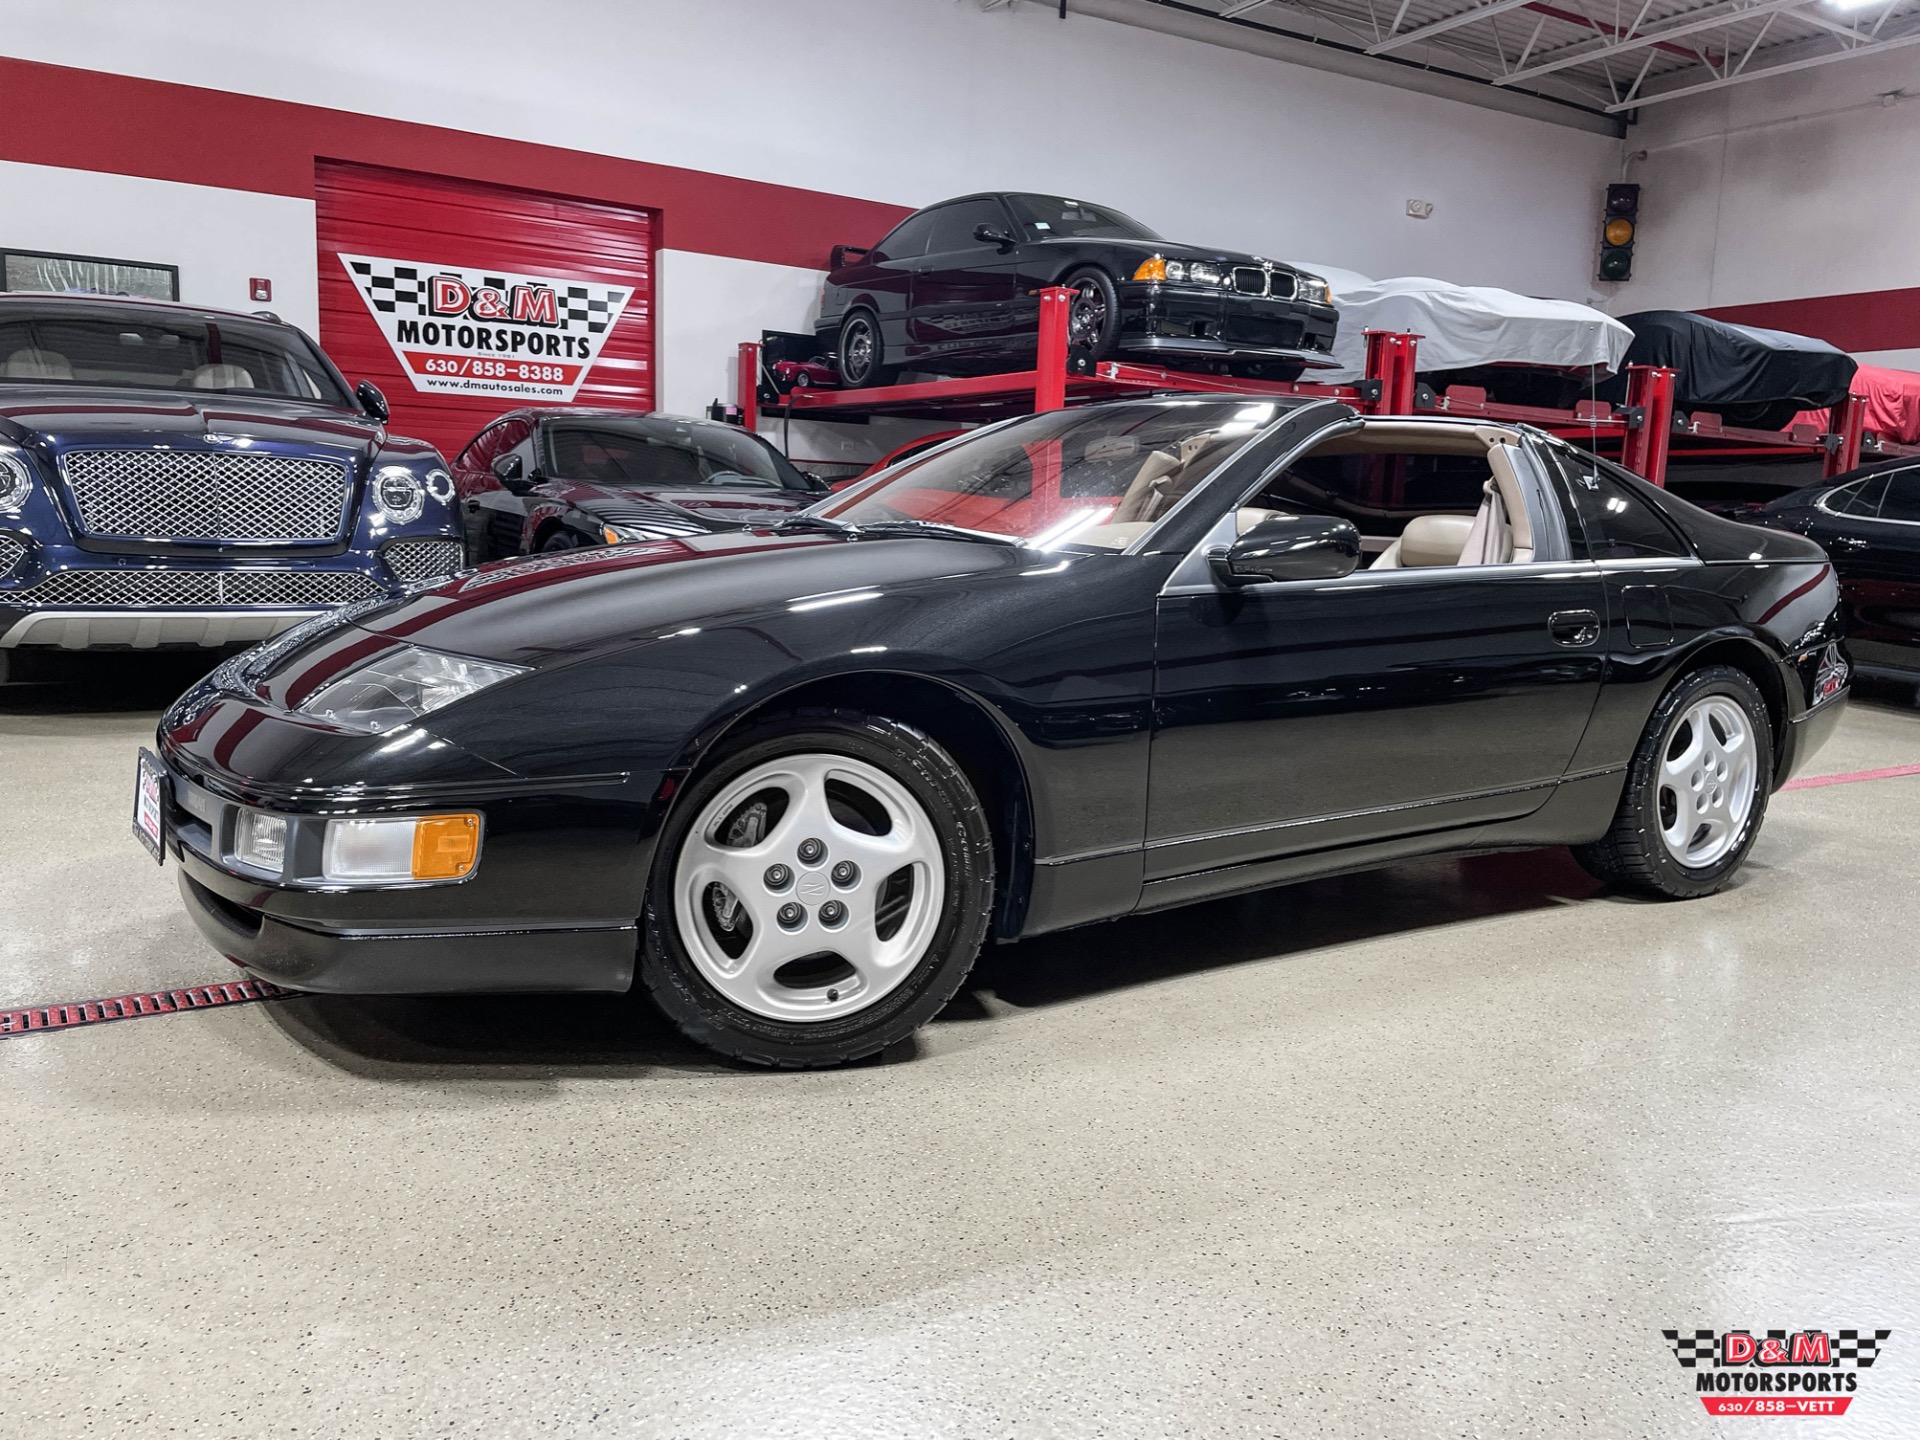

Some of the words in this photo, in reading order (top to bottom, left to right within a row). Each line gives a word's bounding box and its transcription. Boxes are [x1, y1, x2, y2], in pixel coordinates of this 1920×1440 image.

[428, 276, 558, 327] D&M
[397, 320, 590, 359] MOTORSPORTS
[425, 358, 564, 382] 630/858-8388
[427, 380, 563, 395] www.dmautosales.com
